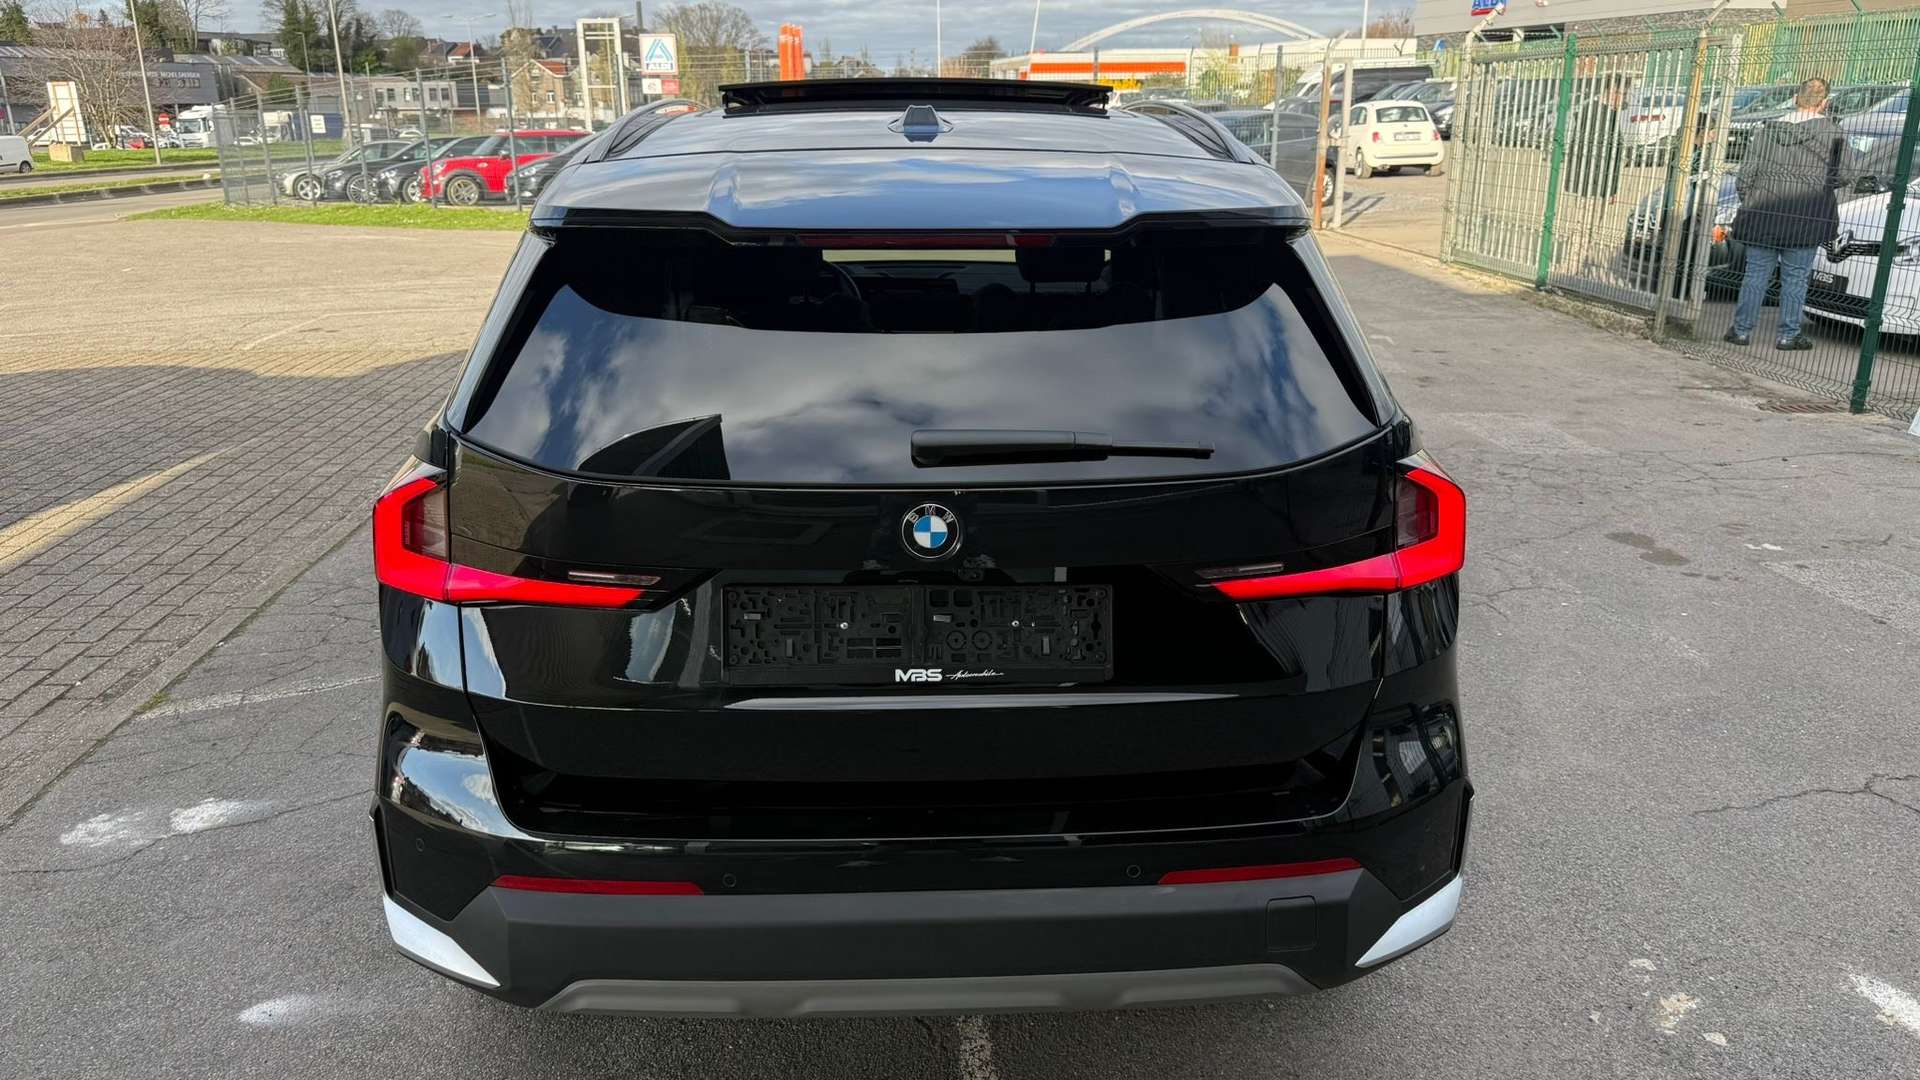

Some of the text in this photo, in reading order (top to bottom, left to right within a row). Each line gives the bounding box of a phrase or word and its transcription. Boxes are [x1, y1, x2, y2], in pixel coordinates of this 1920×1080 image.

[647, 63, 673, 71] ALDI
[907, 505, 954, 523] BMW
[895, 669, 943, 682] MBS
